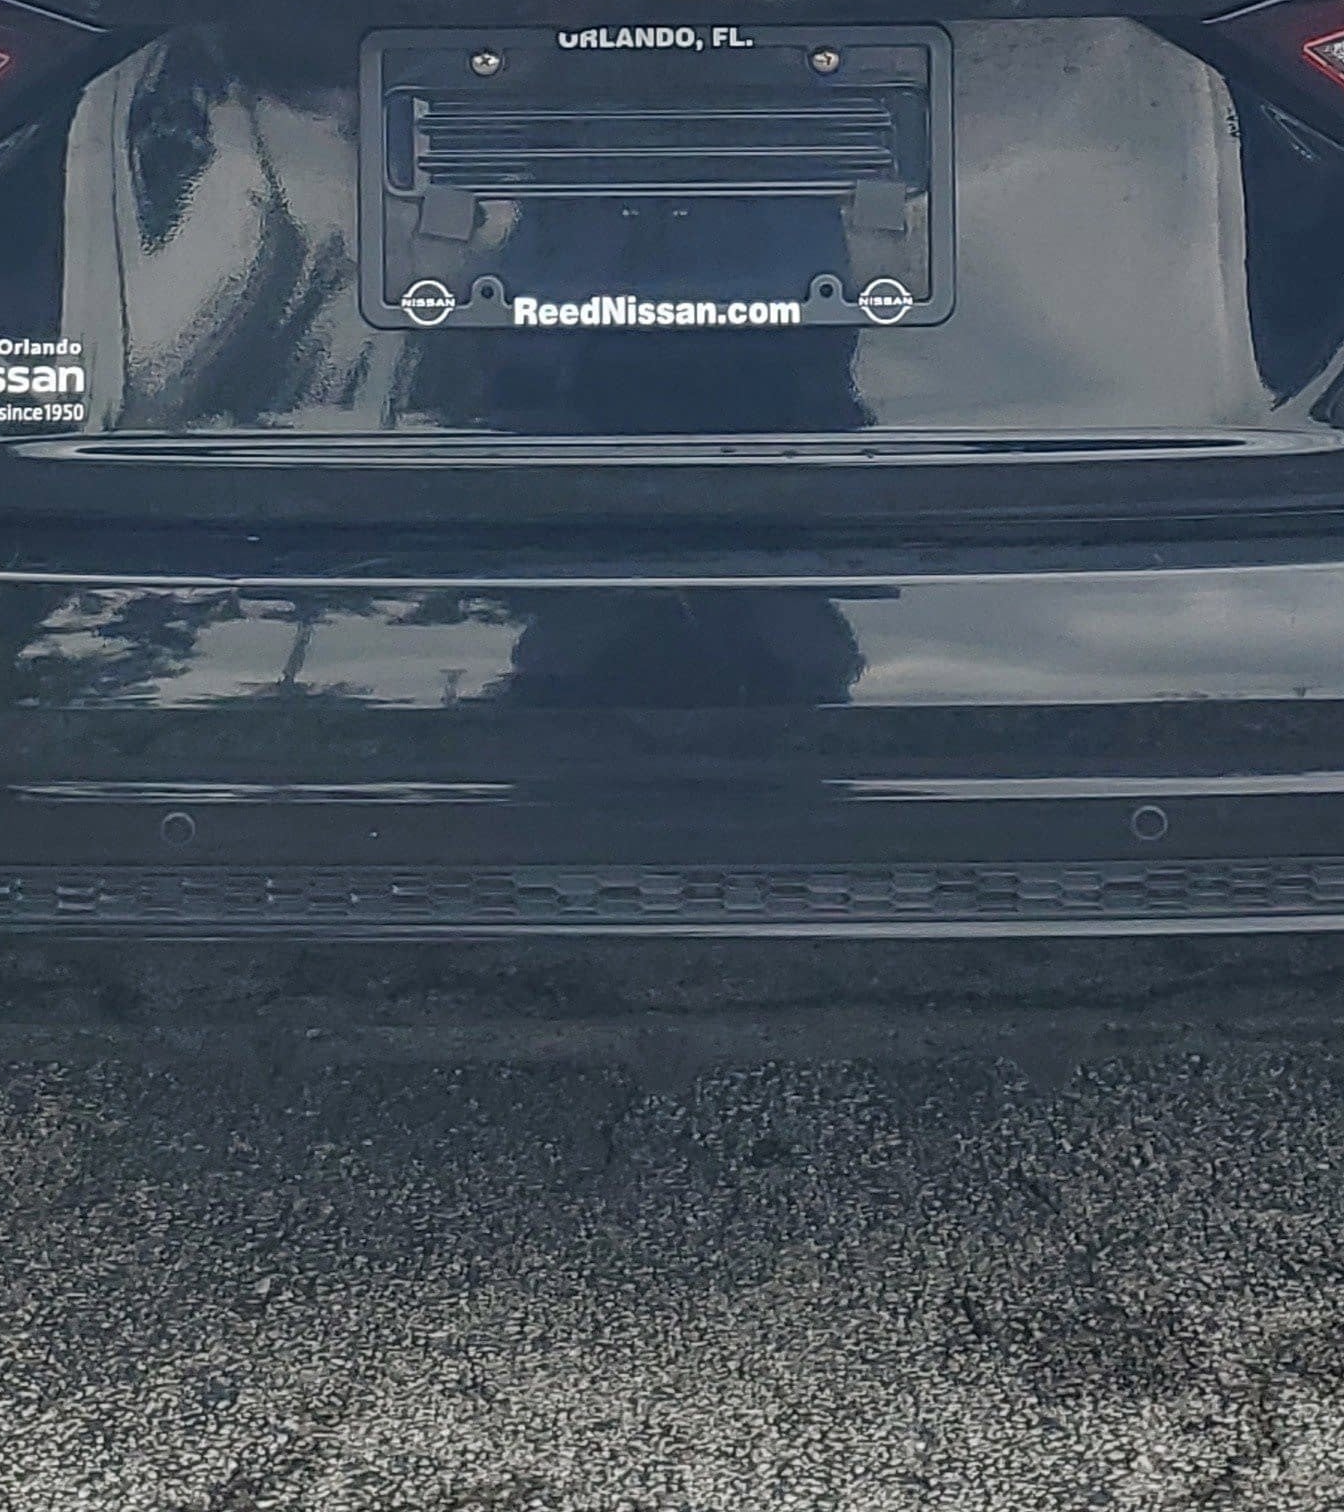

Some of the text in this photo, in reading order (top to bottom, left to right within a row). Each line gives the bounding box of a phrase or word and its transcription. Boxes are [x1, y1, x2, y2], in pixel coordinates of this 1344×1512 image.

[712, 27, 753, 47] FL.
[401, 297, 455, 308] NISSAN
[858, 296, 914, 306] NISSAN
[513, 295, 801, 326] ReedNissan.com
